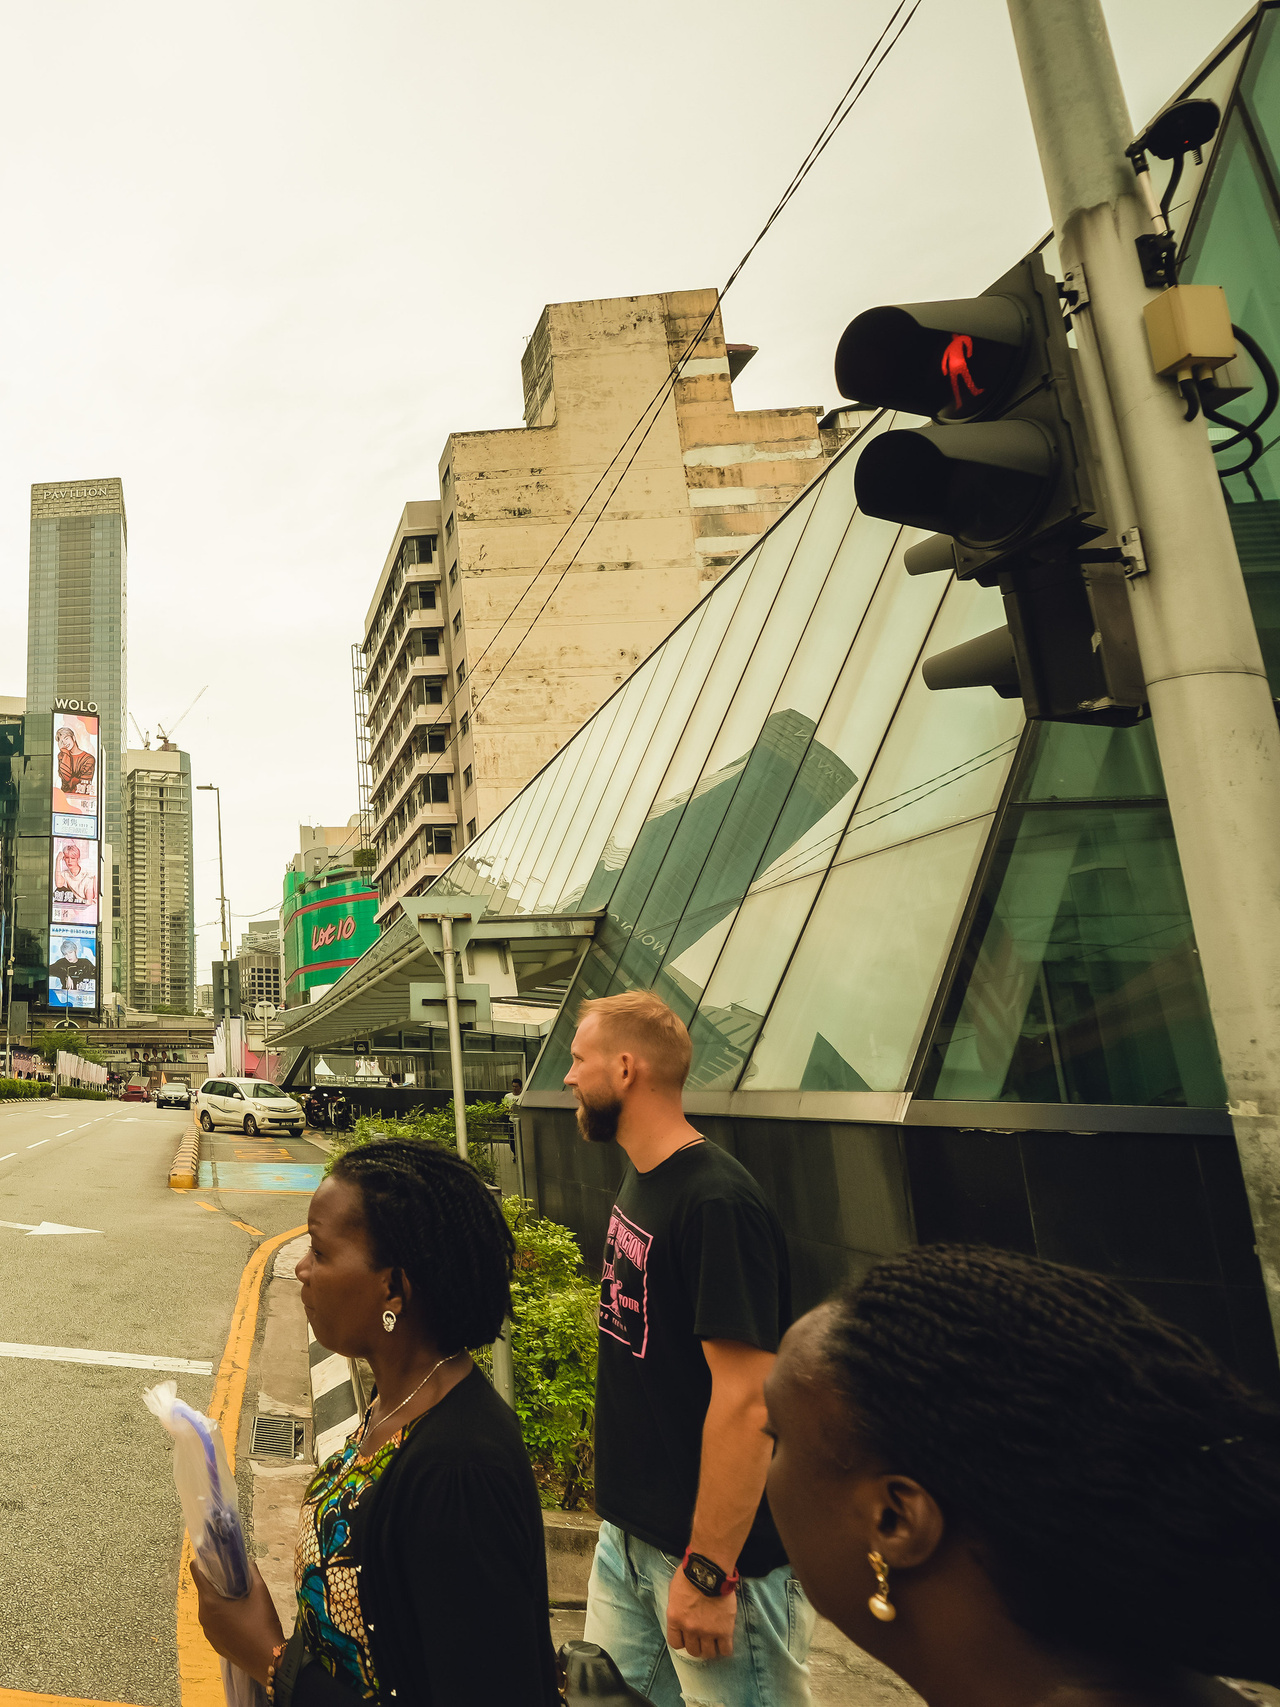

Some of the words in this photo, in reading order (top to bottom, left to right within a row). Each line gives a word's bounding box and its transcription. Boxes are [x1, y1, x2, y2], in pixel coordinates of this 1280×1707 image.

[44, 487, 107, 500] PAVILION
[55, 697, 98, 713] WOLO
[311, 923, 336, 951] Lot
[337, 916, 356, 941] 10
[618, 1293, 641, 1314] TOUR
